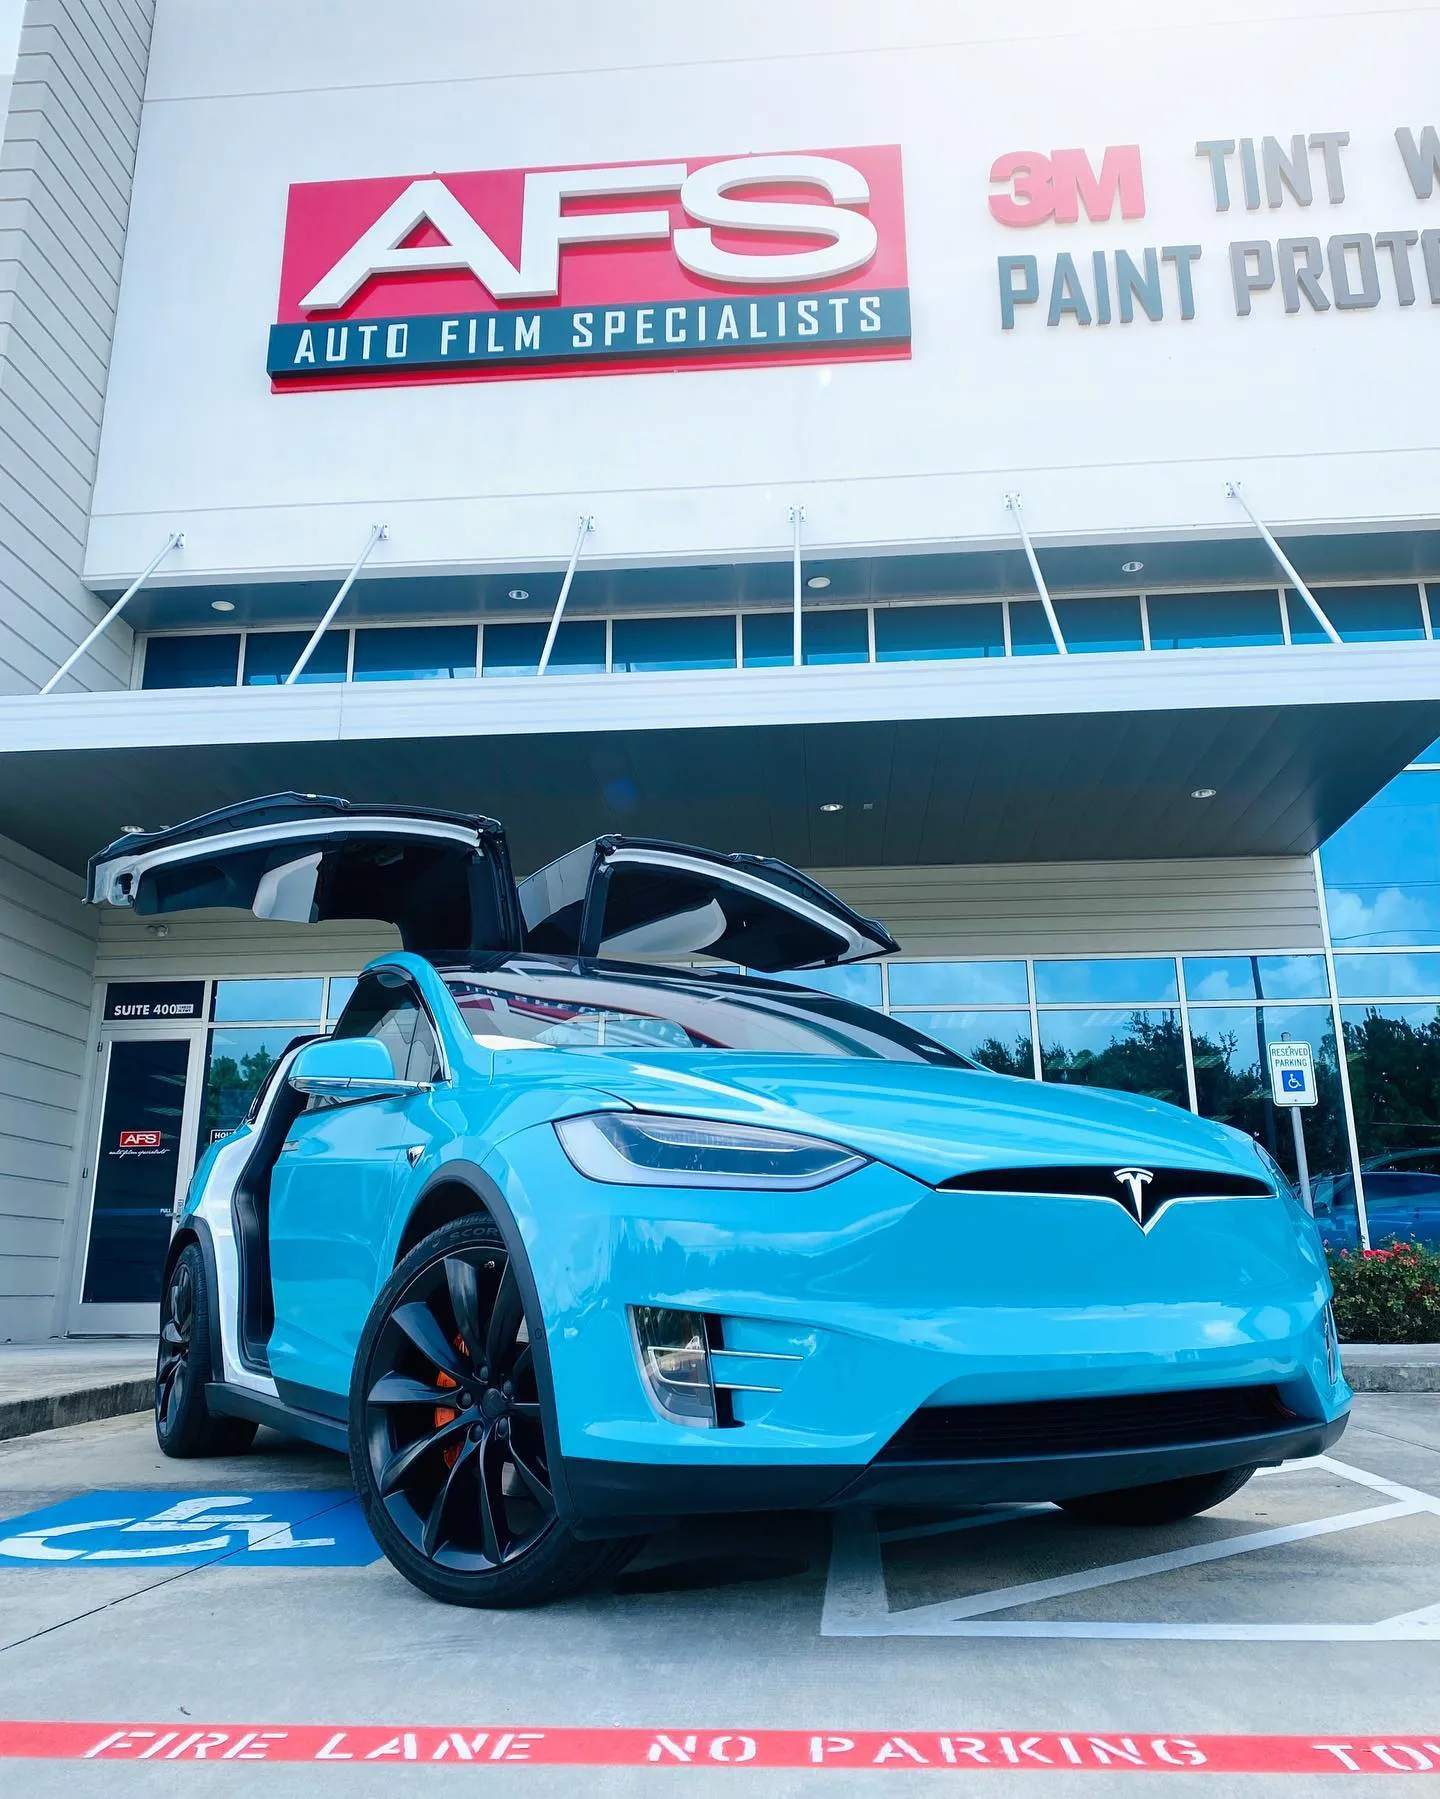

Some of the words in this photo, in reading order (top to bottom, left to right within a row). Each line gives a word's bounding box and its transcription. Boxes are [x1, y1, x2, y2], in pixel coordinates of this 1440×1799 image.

[988, 144, 1146, 228] 3M
[1195, 131, 1351, 212] TINT
[298, 154, 878, 311] AFS
[998, 244, 1202, 329] PAINT
[293, 323, 409, 364] AUTO
[440, 315, 541, 355] FILM
[572, 296, 882, 348] SPECIALISTS
[114, 1004, 150, 1016] SUITE
[153, 1003, 177, 1015] 400
[1271, 1048, 1309, 1057] RESERVED
[1275, 1058, 1308, 1067] PARKING
[124, 1134, 157, 1144] AFS
[82, 1732, 289, 1759] FIRE
[314, 1733, 545, 1760] LANE
[648, 1735, 758, 1762] NO
[810, 1737, 1208, 1766] PARKING
